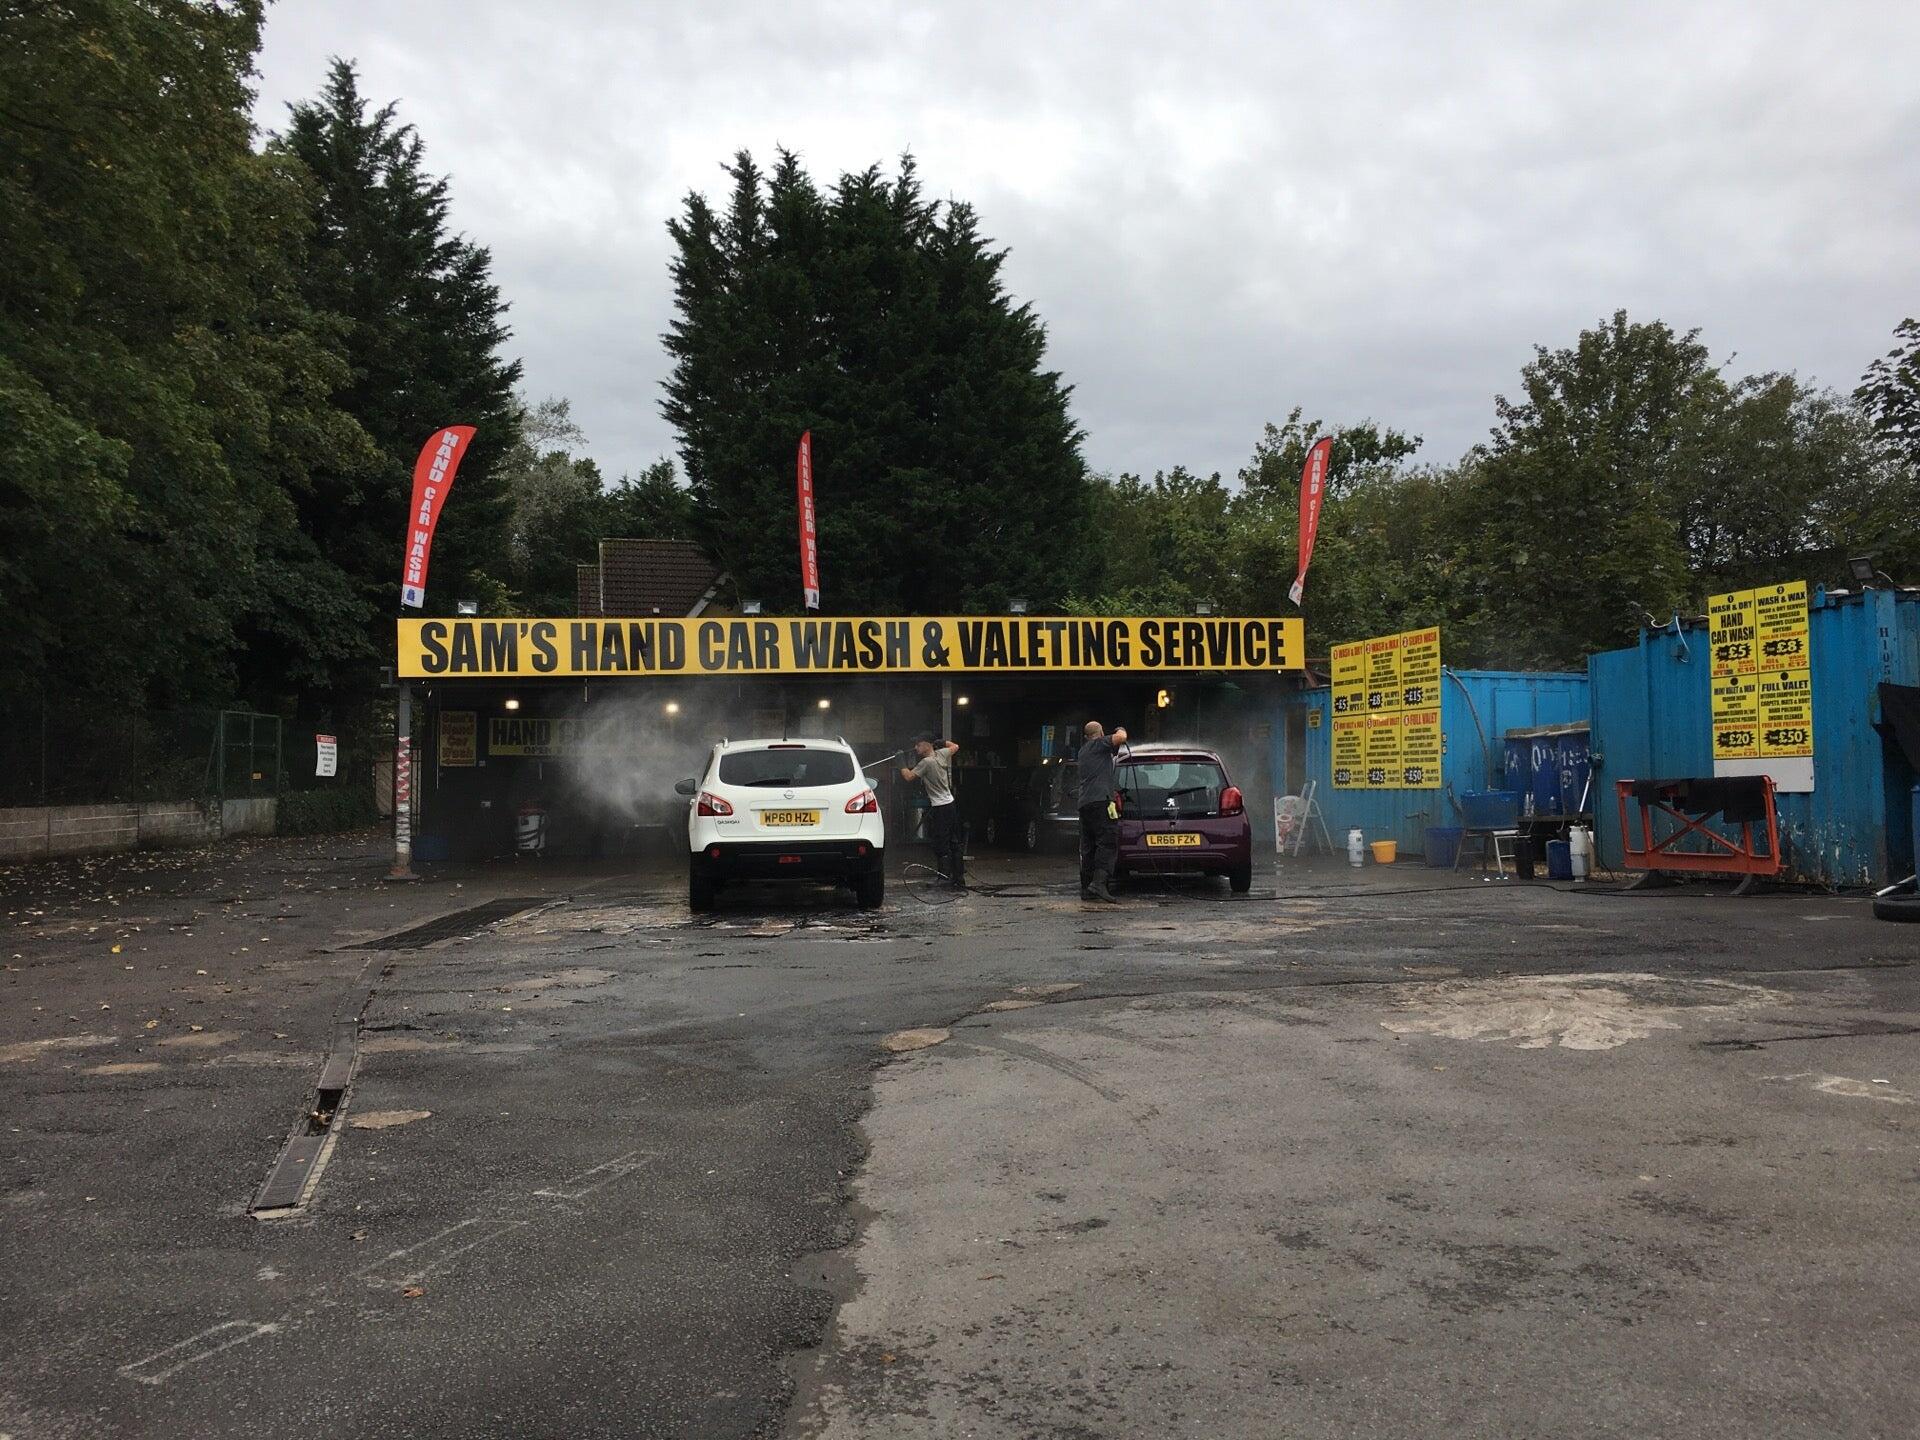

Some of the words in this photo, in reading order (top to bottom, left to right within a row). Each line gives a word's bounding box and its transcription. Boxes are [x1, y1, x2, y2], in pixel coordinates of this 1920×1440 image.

[428, 430, 459, 484] HAND
[801, 442, 809, 491] HAND
[1310, 448, 1324, 495] HAND
[418, 486, 436, 526] CAR
[804, 496, 814, 534] CAR
[407, 530, 428, 584] WASH
[806, 538, 818, 587] WASH
[1758, 596, 1779, 606] WASH
[1788, 592, 1805, 601] WAX
[1710, 604, 1730, 613] WASH
[1739, 601, 1752, 609] DRY
[1721, 612, 1743, 628] HAND
[1711, 630, 1728, 645] CAR
[1729, 626, 1754, 642] WASH
[420, 622, 558, 674] SAM'S
[570, 622, 686, 672] HAND
[698, 620, 780, 672] CAR
[789, 620, 911, 670] WASH
[921, 620, 950, 668] &
[958, 620, 1130, 668] VALETING
[1139, 620, 1286, 667] SERVICE
[1729, 645, 1746, 657] £5
[1777, 641, 1797, 652] £8
[1762, 682, 1779, 692] FULL
[1782, 680, 1809, 690] VALET
[1372, 695, 1381, 706] £8
[1409, 690, 1422, 702] £15
[492, 720, 551, 746] HAND
[1728, 733, 1749, 745] £20
[1779, 731, 1803, 743] £50
[1372, 771, 1384, 782] £25
[1408, 771, 1422, 781] £50
[795, 813, 816, 823] HZL
[1150, 836, 1175, 844] LR66
[1177, 835, 1195, 844] FZK
